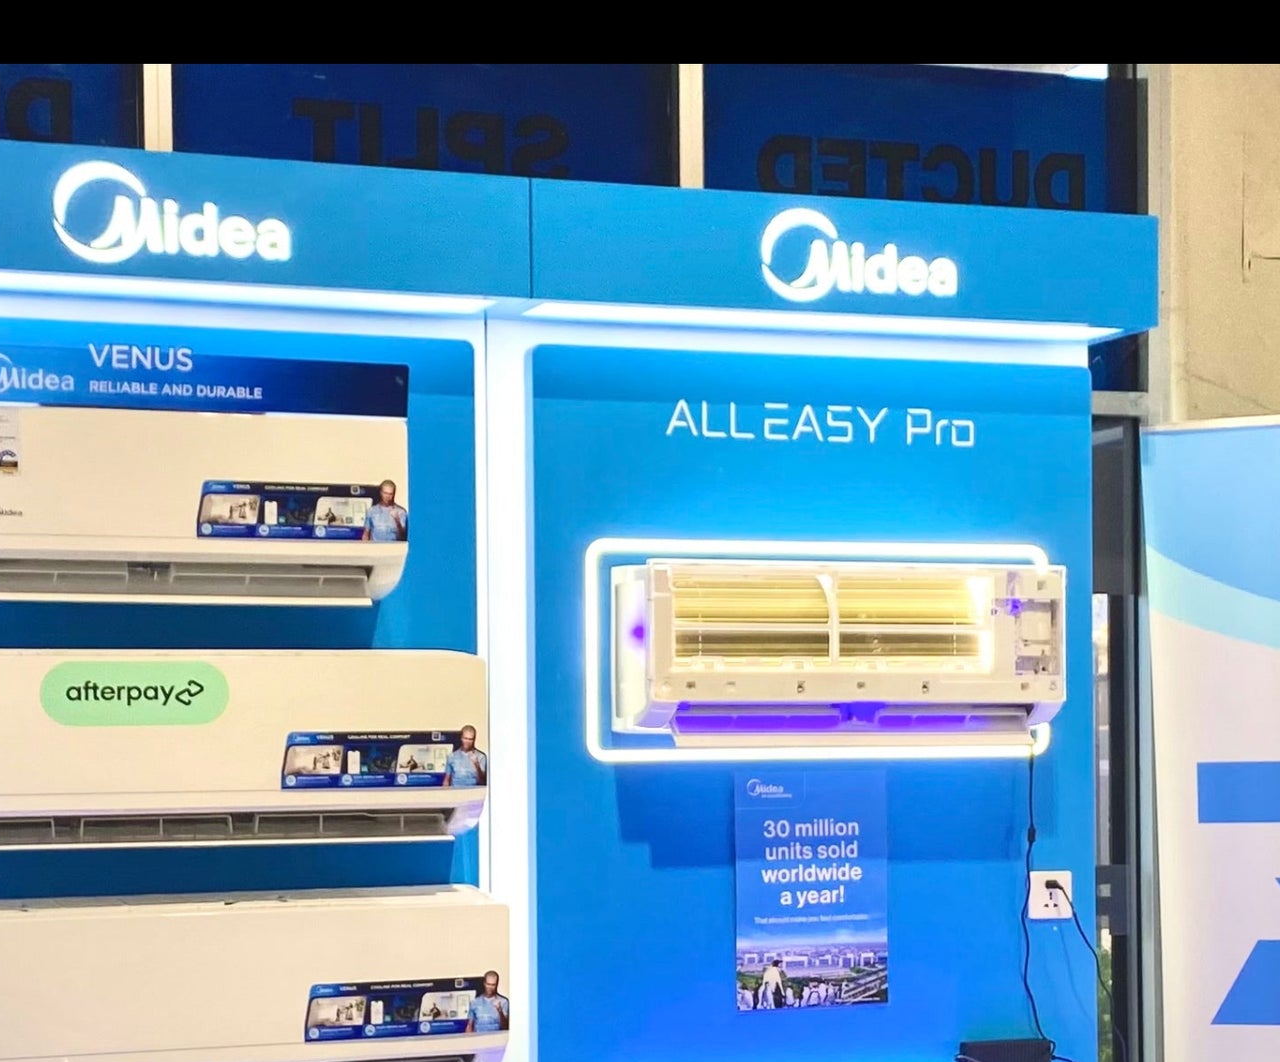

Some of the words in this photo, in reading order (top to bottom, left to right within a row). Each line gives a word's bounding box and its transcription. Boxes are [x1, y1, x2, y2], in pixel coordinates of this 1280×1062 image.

[52, 159, 292, 263] Midea
[759, 206, 959, 303] Midea
[87, 343, 194, 373] VENUS
[88, 379, 159, 396] RELIABLE
[161, 381, 193, 396] AND
[196, 383, 264, 400] DURABLE
[906, 407, 975, 448] Pro
[65, 680, 175, 708] afterpay
[762, 819, 791, 839] 30
[794, 818, 860, 838] million
[764, 841, 814, 861] units
[816, 840, 859, 860] sold
[760, 862, 864, 884] worldwide
[779, 891, 793, 907] a
[795, 885, 845, 909] year!
